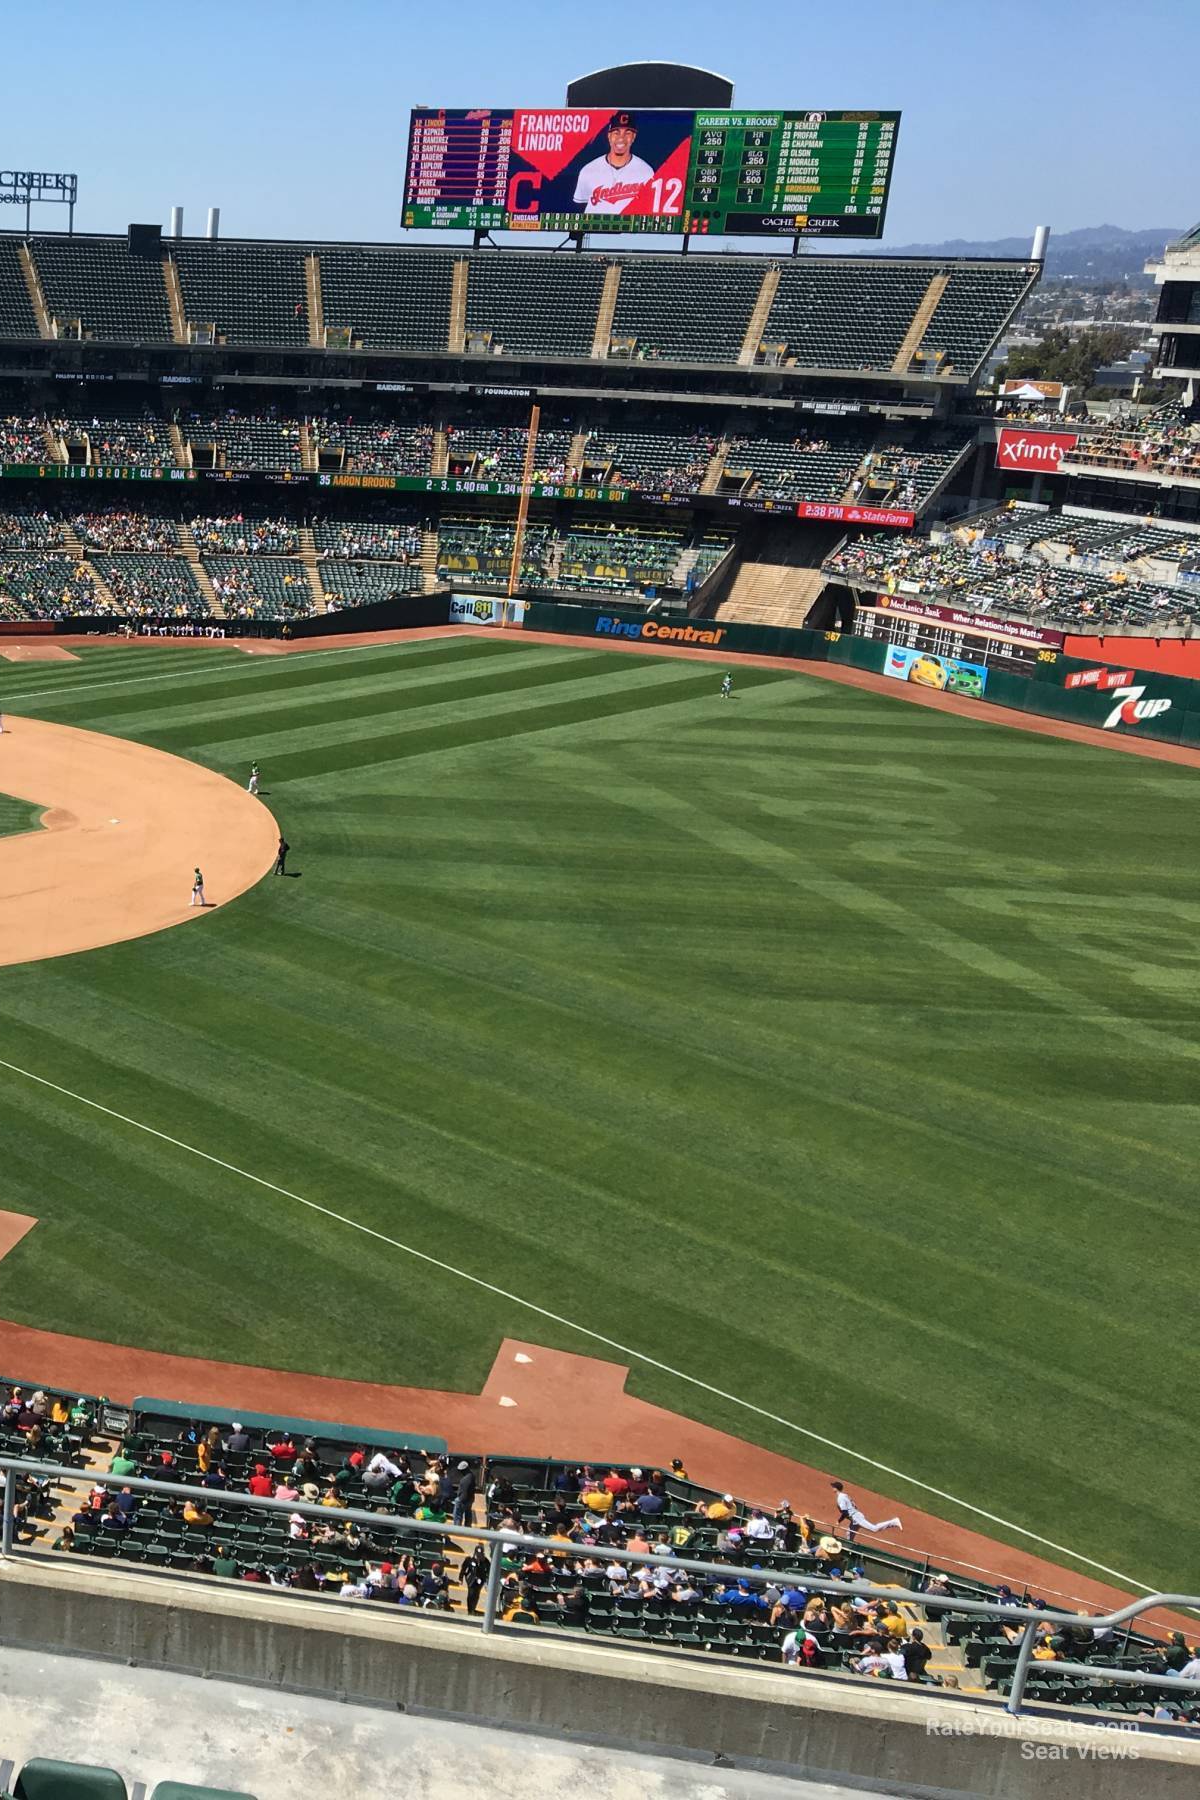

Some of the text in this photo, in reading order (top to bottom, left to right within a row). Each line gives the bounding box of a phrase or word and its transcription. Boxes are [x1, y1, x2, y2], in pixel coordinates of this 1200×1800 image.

[520, 114, 590, 132] FRANCISCO
[699, 117, 778, 126] CAREER VS. BROOKS
[518, 134, 564, 151] LINDOR
[788, 167, 819, 176] PISCOTTY
[787, 176, 819, 184] LAUREANO
[852, 177, 860, 185] CF
[507, 171, 542, 214] C
[651, 178, 682, 214] 12
[784, 194, 812, 203] HUNDLEY
[844, 205, 857, 214] ERA
[866, 205, 880, 214] 5.40
[762, 218, 840, 227] CACHE CREEK
[140, 467, 152, 478] CLE
[171, 469, 184, 479] OAK
[320, 474, 330, 485] 35
[333, 476, 360, 487] AARON
[362, 476, 396, 488] BROOKS
[456, 482, 475, 492] 5.40
[497, 484, 515, 494] 1.34
[542, 486, 554, 497] 28
[563, 487, 575, 497] 30
[584, 488, 597, 498] 50
[805, 505, 844, 519] 2:38 PM
[452, 602, 492, 614] Call 811
[890, 599, 941, 617] Mechanics Bank
[595, 616, 723, 645] RingCentral
[953, 613, 974, 625] Where
[1020, 627, 1044, 639] Matter
[824, 631, 840, 642] 367
[1038, 650, 1057, 663] 362
[1071, 670, 1127, 686] DO MORE WITH
